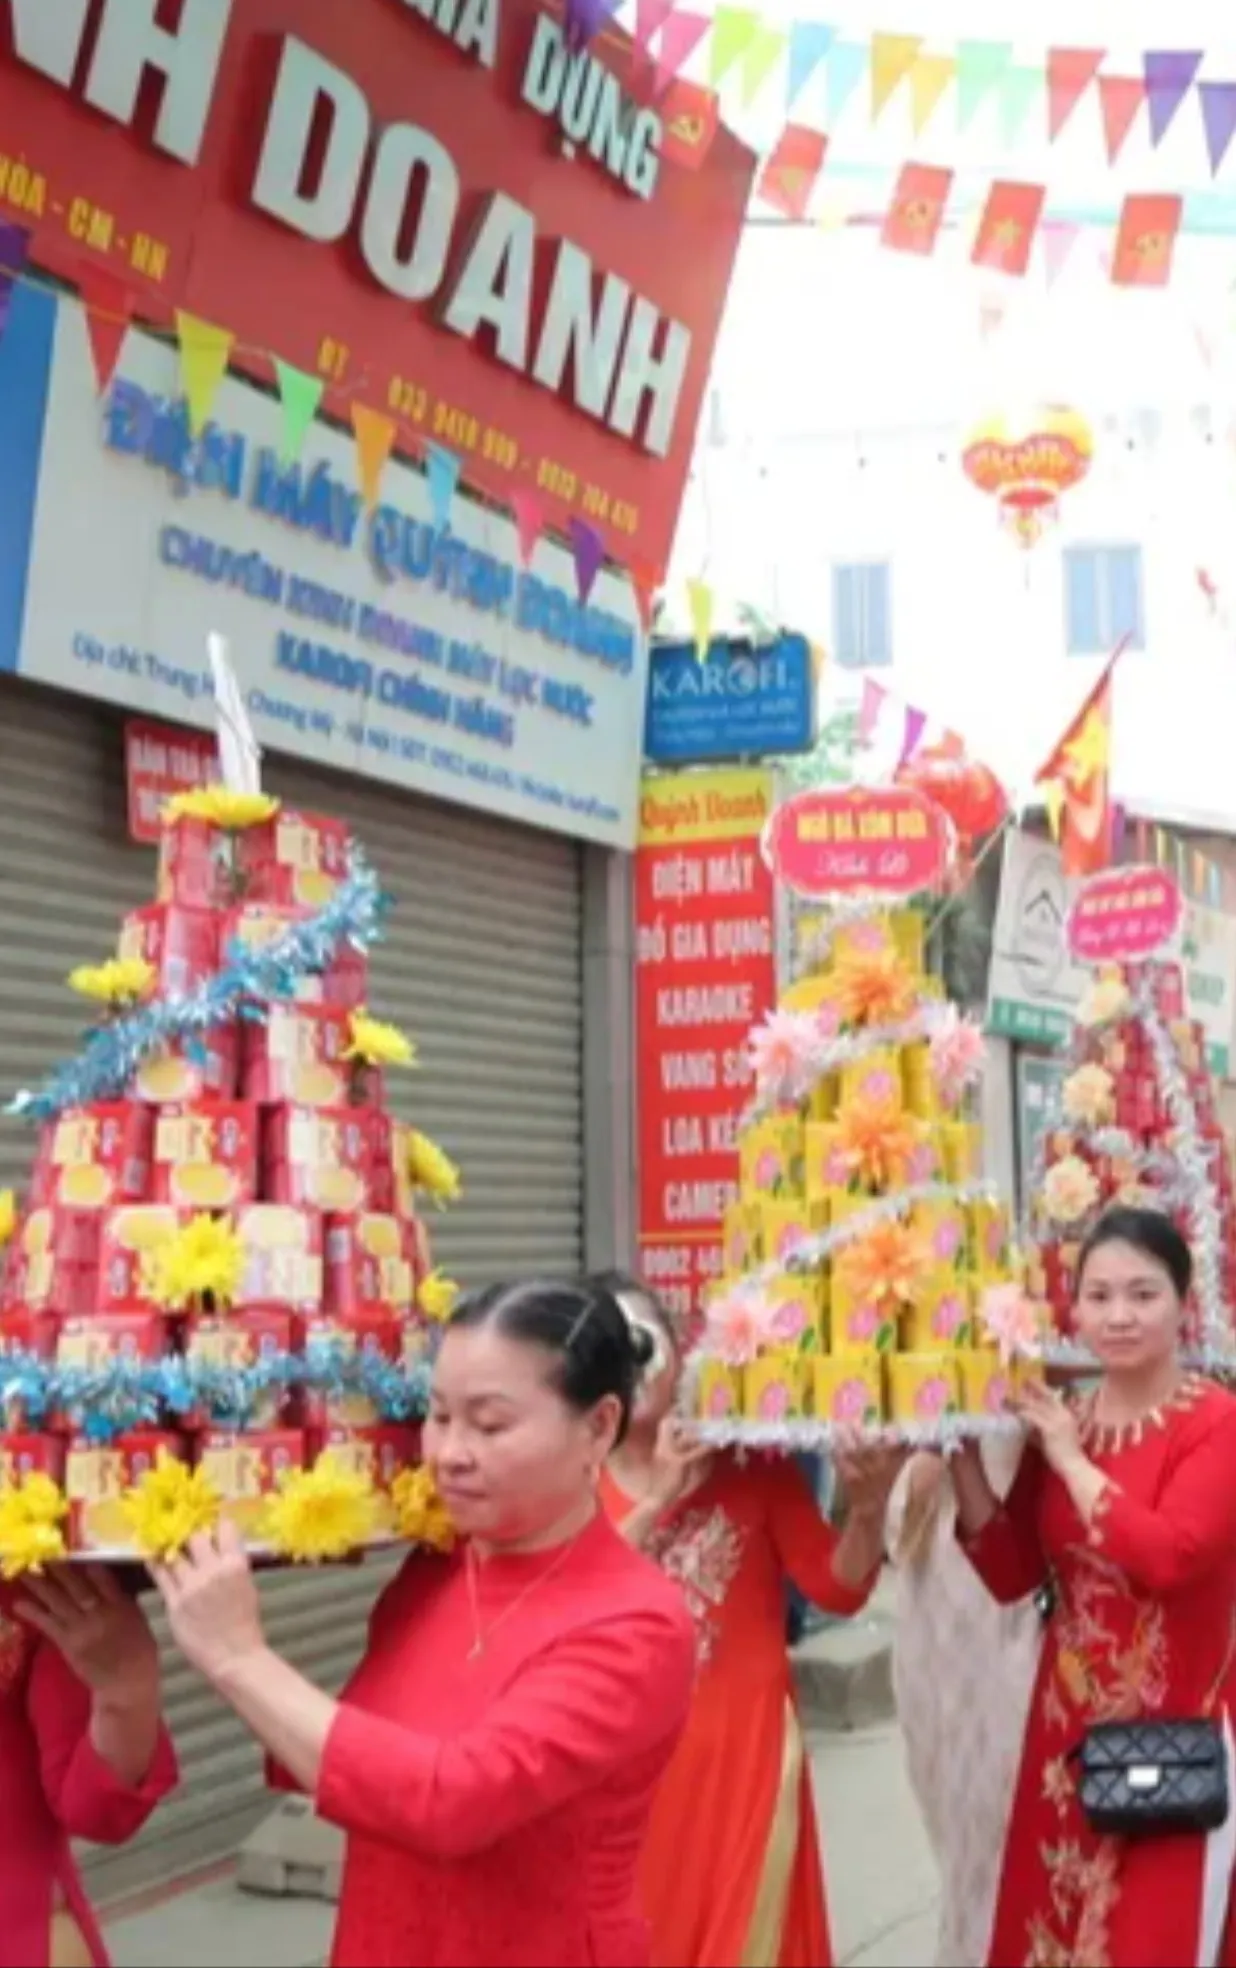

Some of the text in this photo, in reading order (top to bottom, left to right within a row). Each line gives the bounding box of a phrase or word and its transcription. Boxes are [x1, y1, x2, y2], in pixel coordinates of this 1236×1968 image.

[400, 0, 663, 201] IA DỤNG
[252, 33, 692, 459] DOANH
[250, 446, 363, 549] MÁY
[652, 848, 754, 908] ĐIỆN MÁY
[671, 920, 708, 961] GIA
[712, 916, 771, 967] DỤNG
[656, 981, 754, 1028] KARAOKE
[660, 1050, 716, 1093] VANG
[662, 1107, 741, 1157] LOA KÉ
